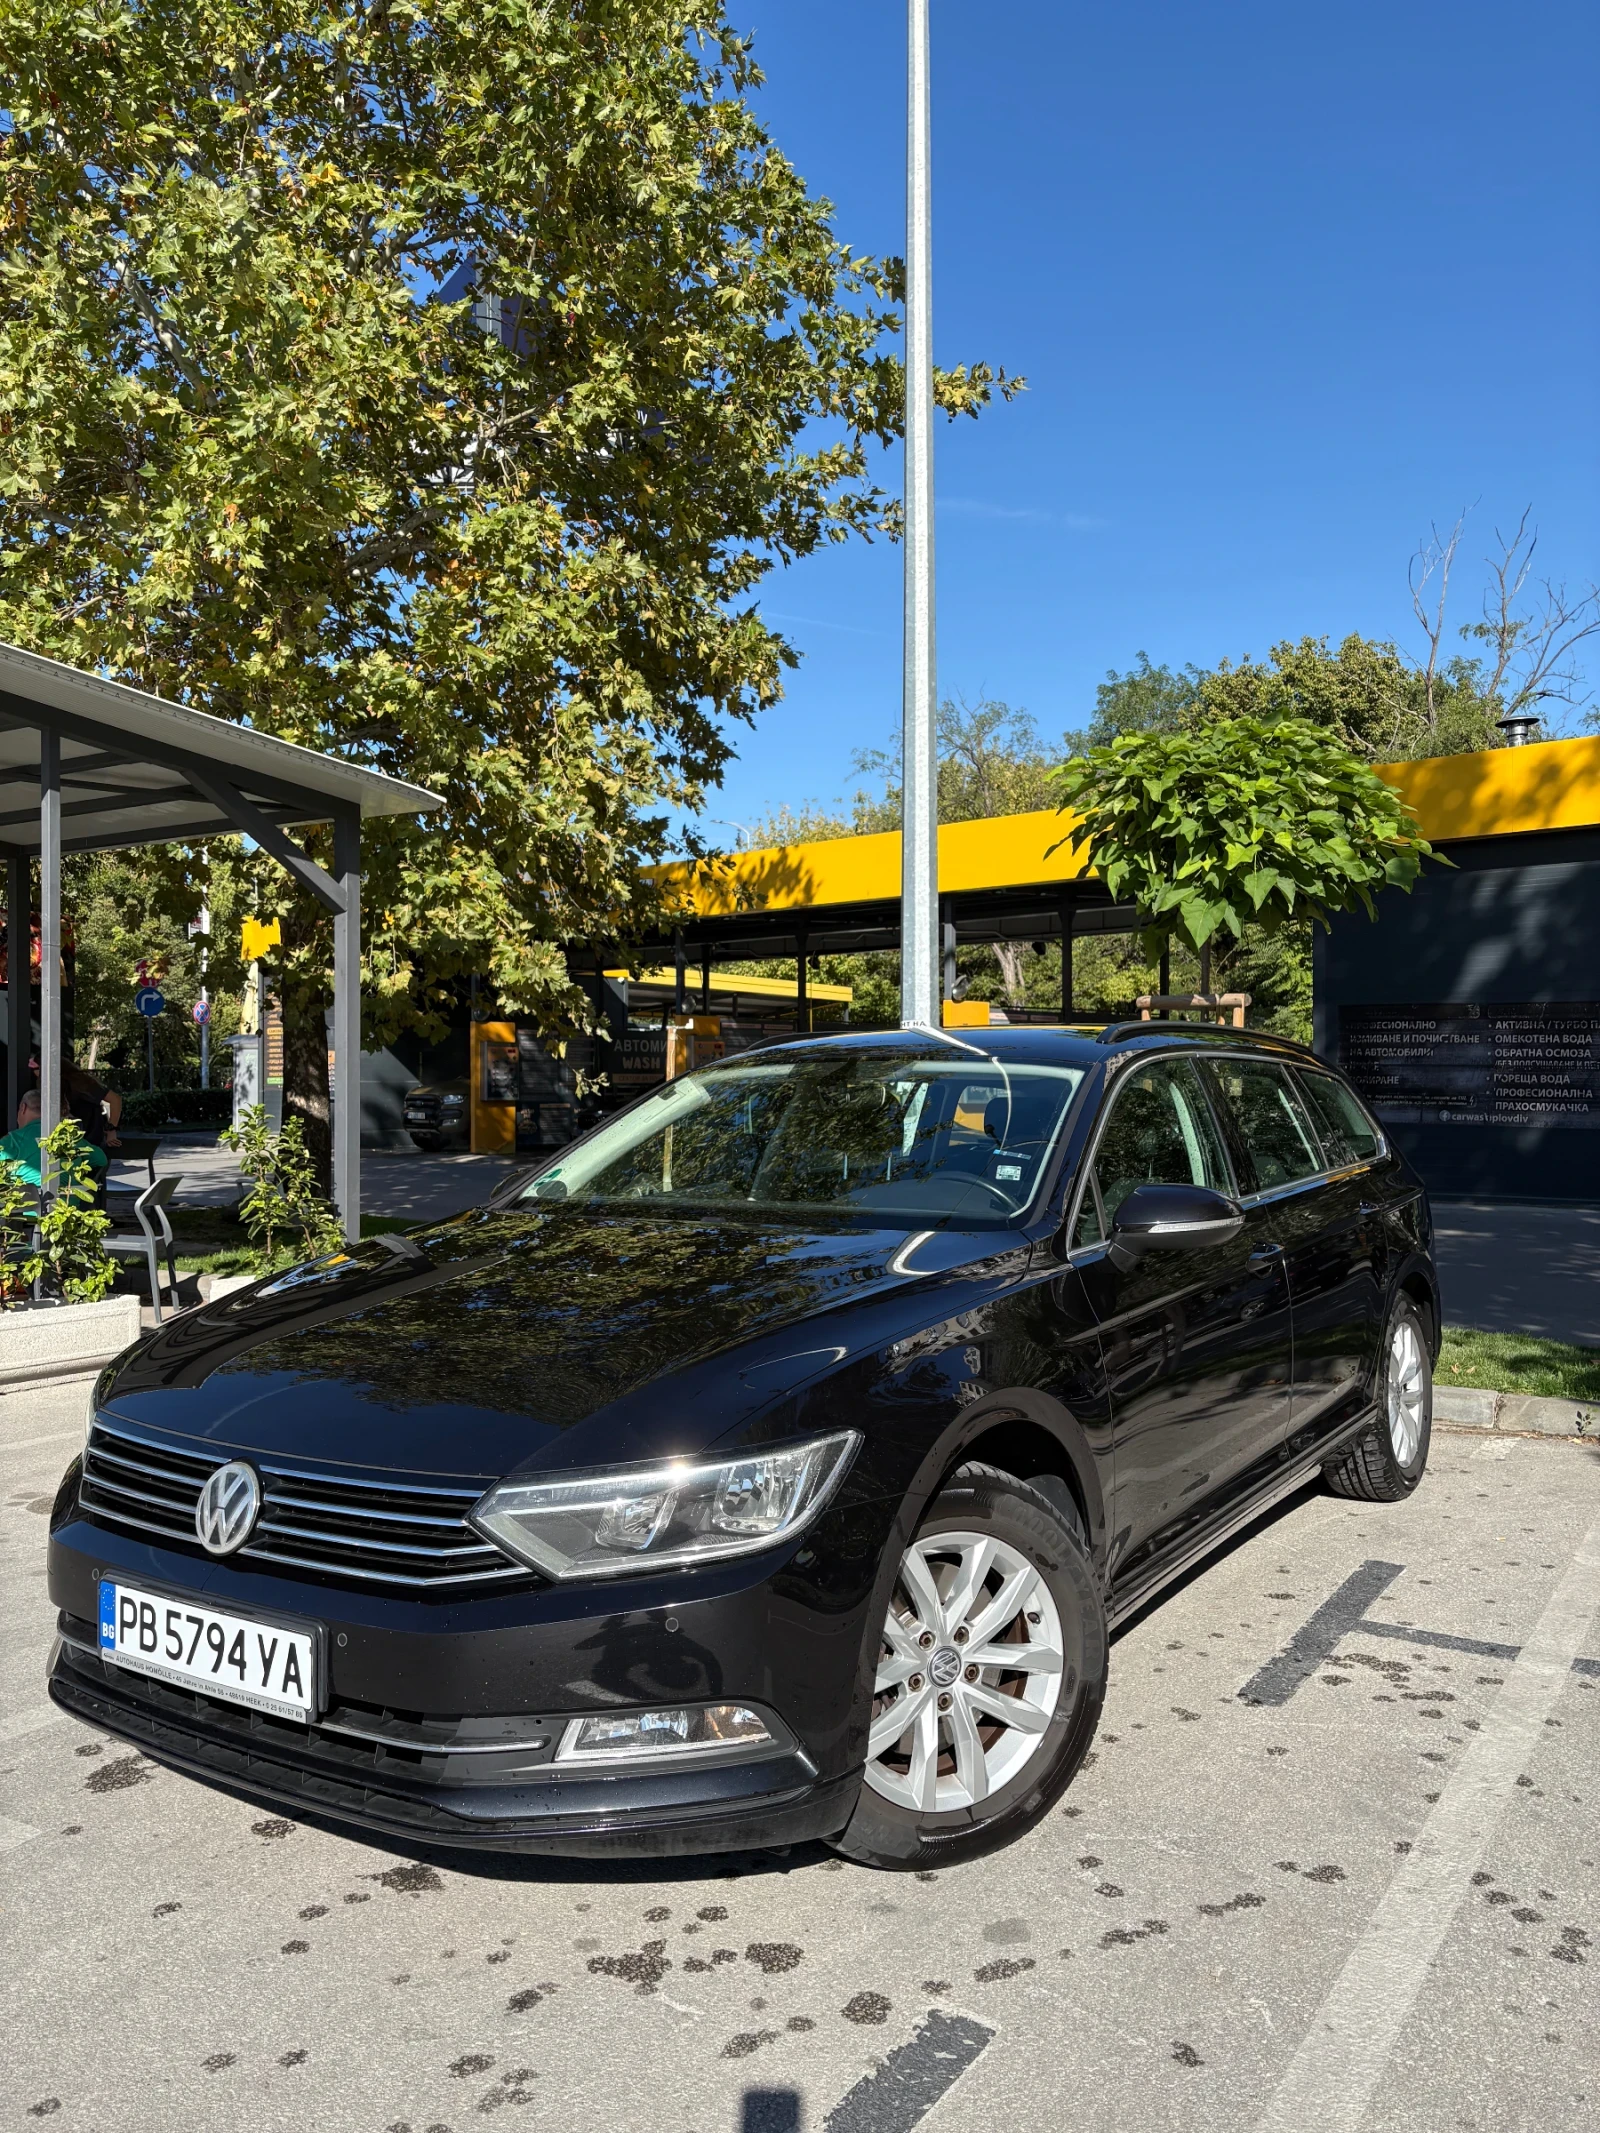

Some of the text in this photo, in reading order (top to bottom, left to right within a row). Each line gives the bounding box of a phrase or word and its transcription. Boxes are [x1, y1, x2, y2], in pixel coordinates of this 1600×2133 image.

[1350, 1020, 1437, 1030] ПРОФЕСИОНАЛНО
[1495, 1020, 1545, 1030] АКТИВНА
[1553, 1020, 1588, 1030] ТУРБО
[1590, 1019, 1600, 1029] П
[1350, 1034, 1480, 1044] ИЗМИВАНЕ И ПОЧИСТВАНЕ
[1494, 1034, 1593, 1045] ОМЕКОТЕНА ВОДА
[1350, 1047, 1434, 1057] НА АВТОМОБИЛИ
[1494, 1048, 1592, 1058] ОБРАТНА ОСМОЗА
[622, 1056, 661, 1069] WASH
[1493, 1073, 1571, 1085] ГОРЕЩА ВОДА
[1495, 1088, 1593, 1098] ПРОФЕСИОНАЛНА
[1495, 1101, 1589, 1112] ПРАХОСМУКАЧКА
[102, 1622, 115, 1640] BG
[116, 1655, 145, 1670] AUTOHAUS
[245, 1696, 262, 1707] HEEK
